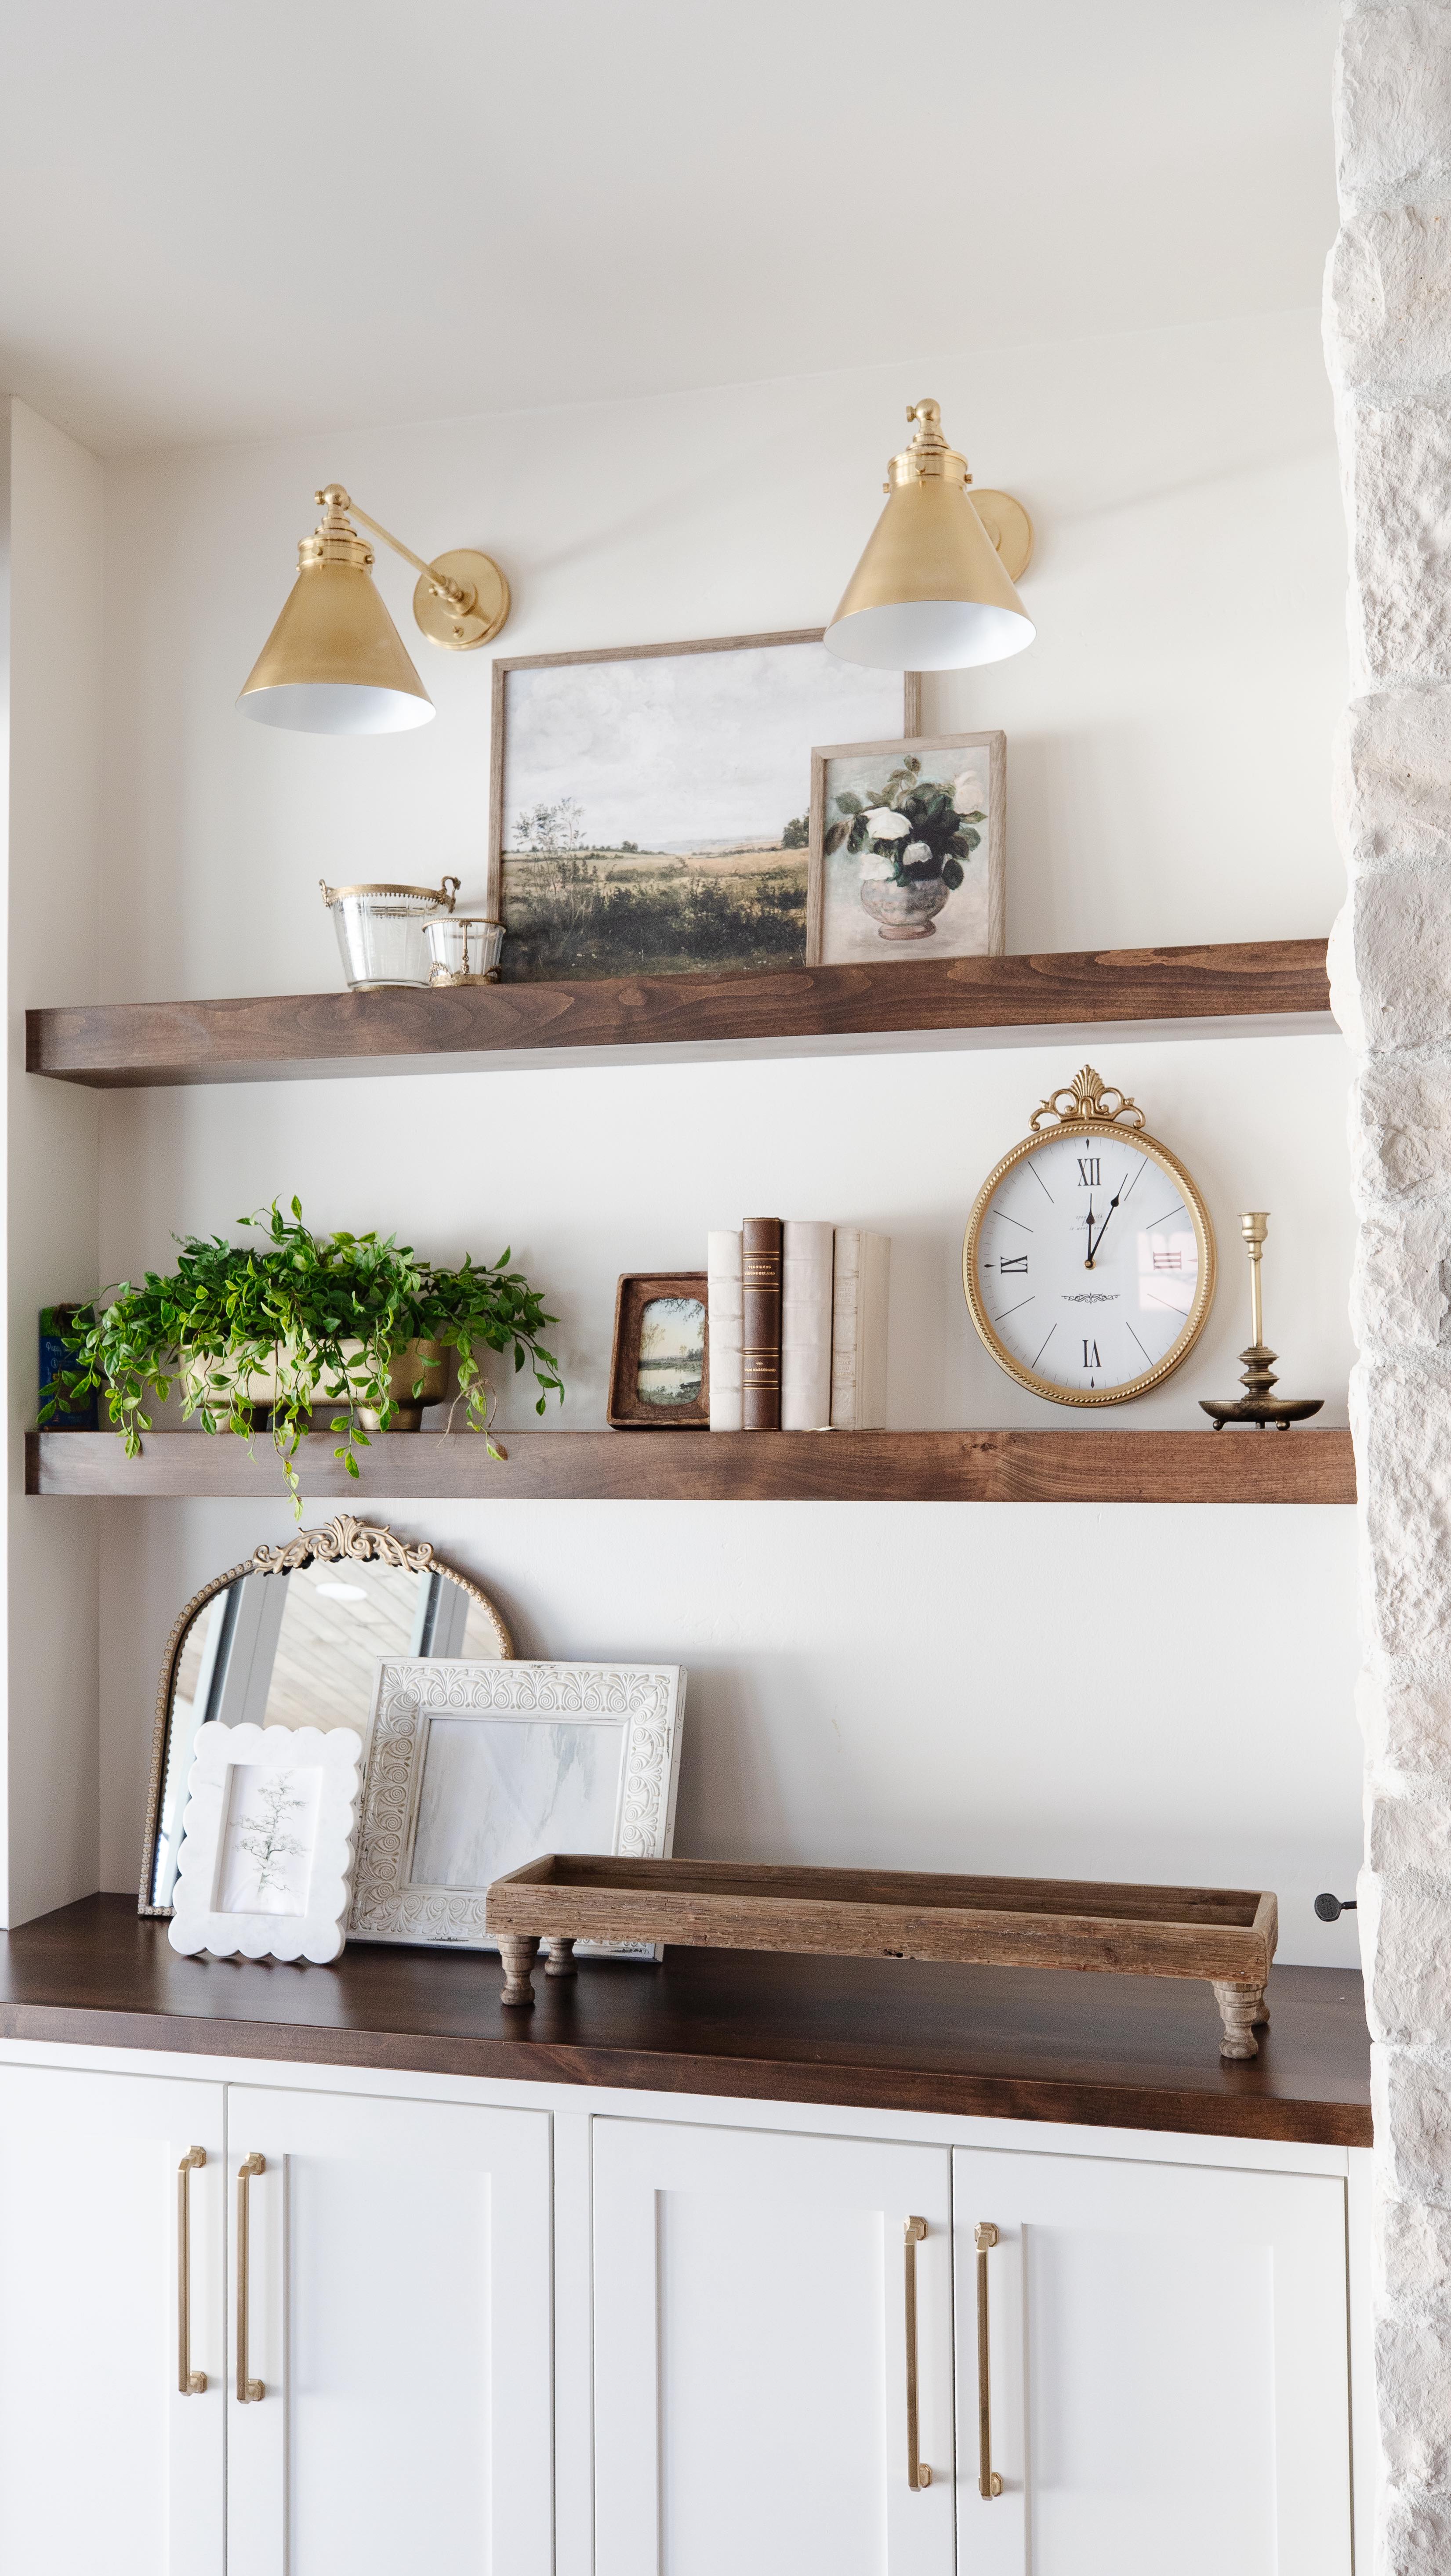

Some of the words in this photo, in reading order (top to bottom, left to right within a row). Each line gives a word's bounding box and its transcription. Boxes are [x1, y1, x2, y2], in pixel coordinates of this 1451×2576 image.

[1077, 1158, 1102, 1186] XII
[1000, 1255, 1028, 1274] IX
[1153, 1251, 1182, 1271] III
[1082, 1339, 1102, 1368] VI
